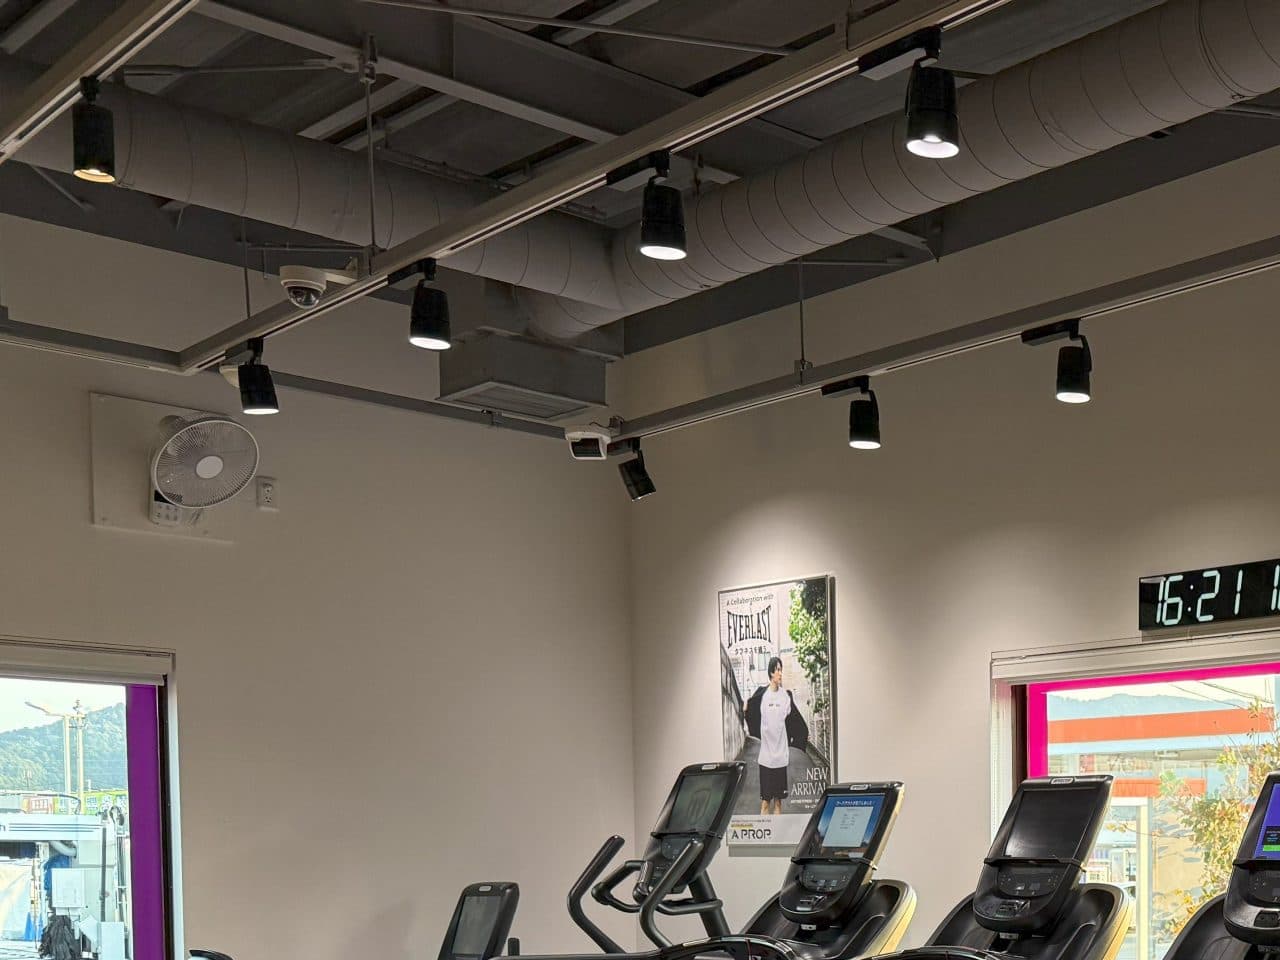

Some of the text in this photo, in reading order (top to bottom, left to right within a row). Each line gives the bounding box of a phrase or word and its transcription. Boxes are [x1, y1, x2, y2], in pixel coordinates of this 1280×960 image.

[1156, 569, 1243, 626] 16:21
[727, 604, 772, 649] EVERLAST
[806, 767, 828, 781] NEW
[731, 829, 739, 840] A
